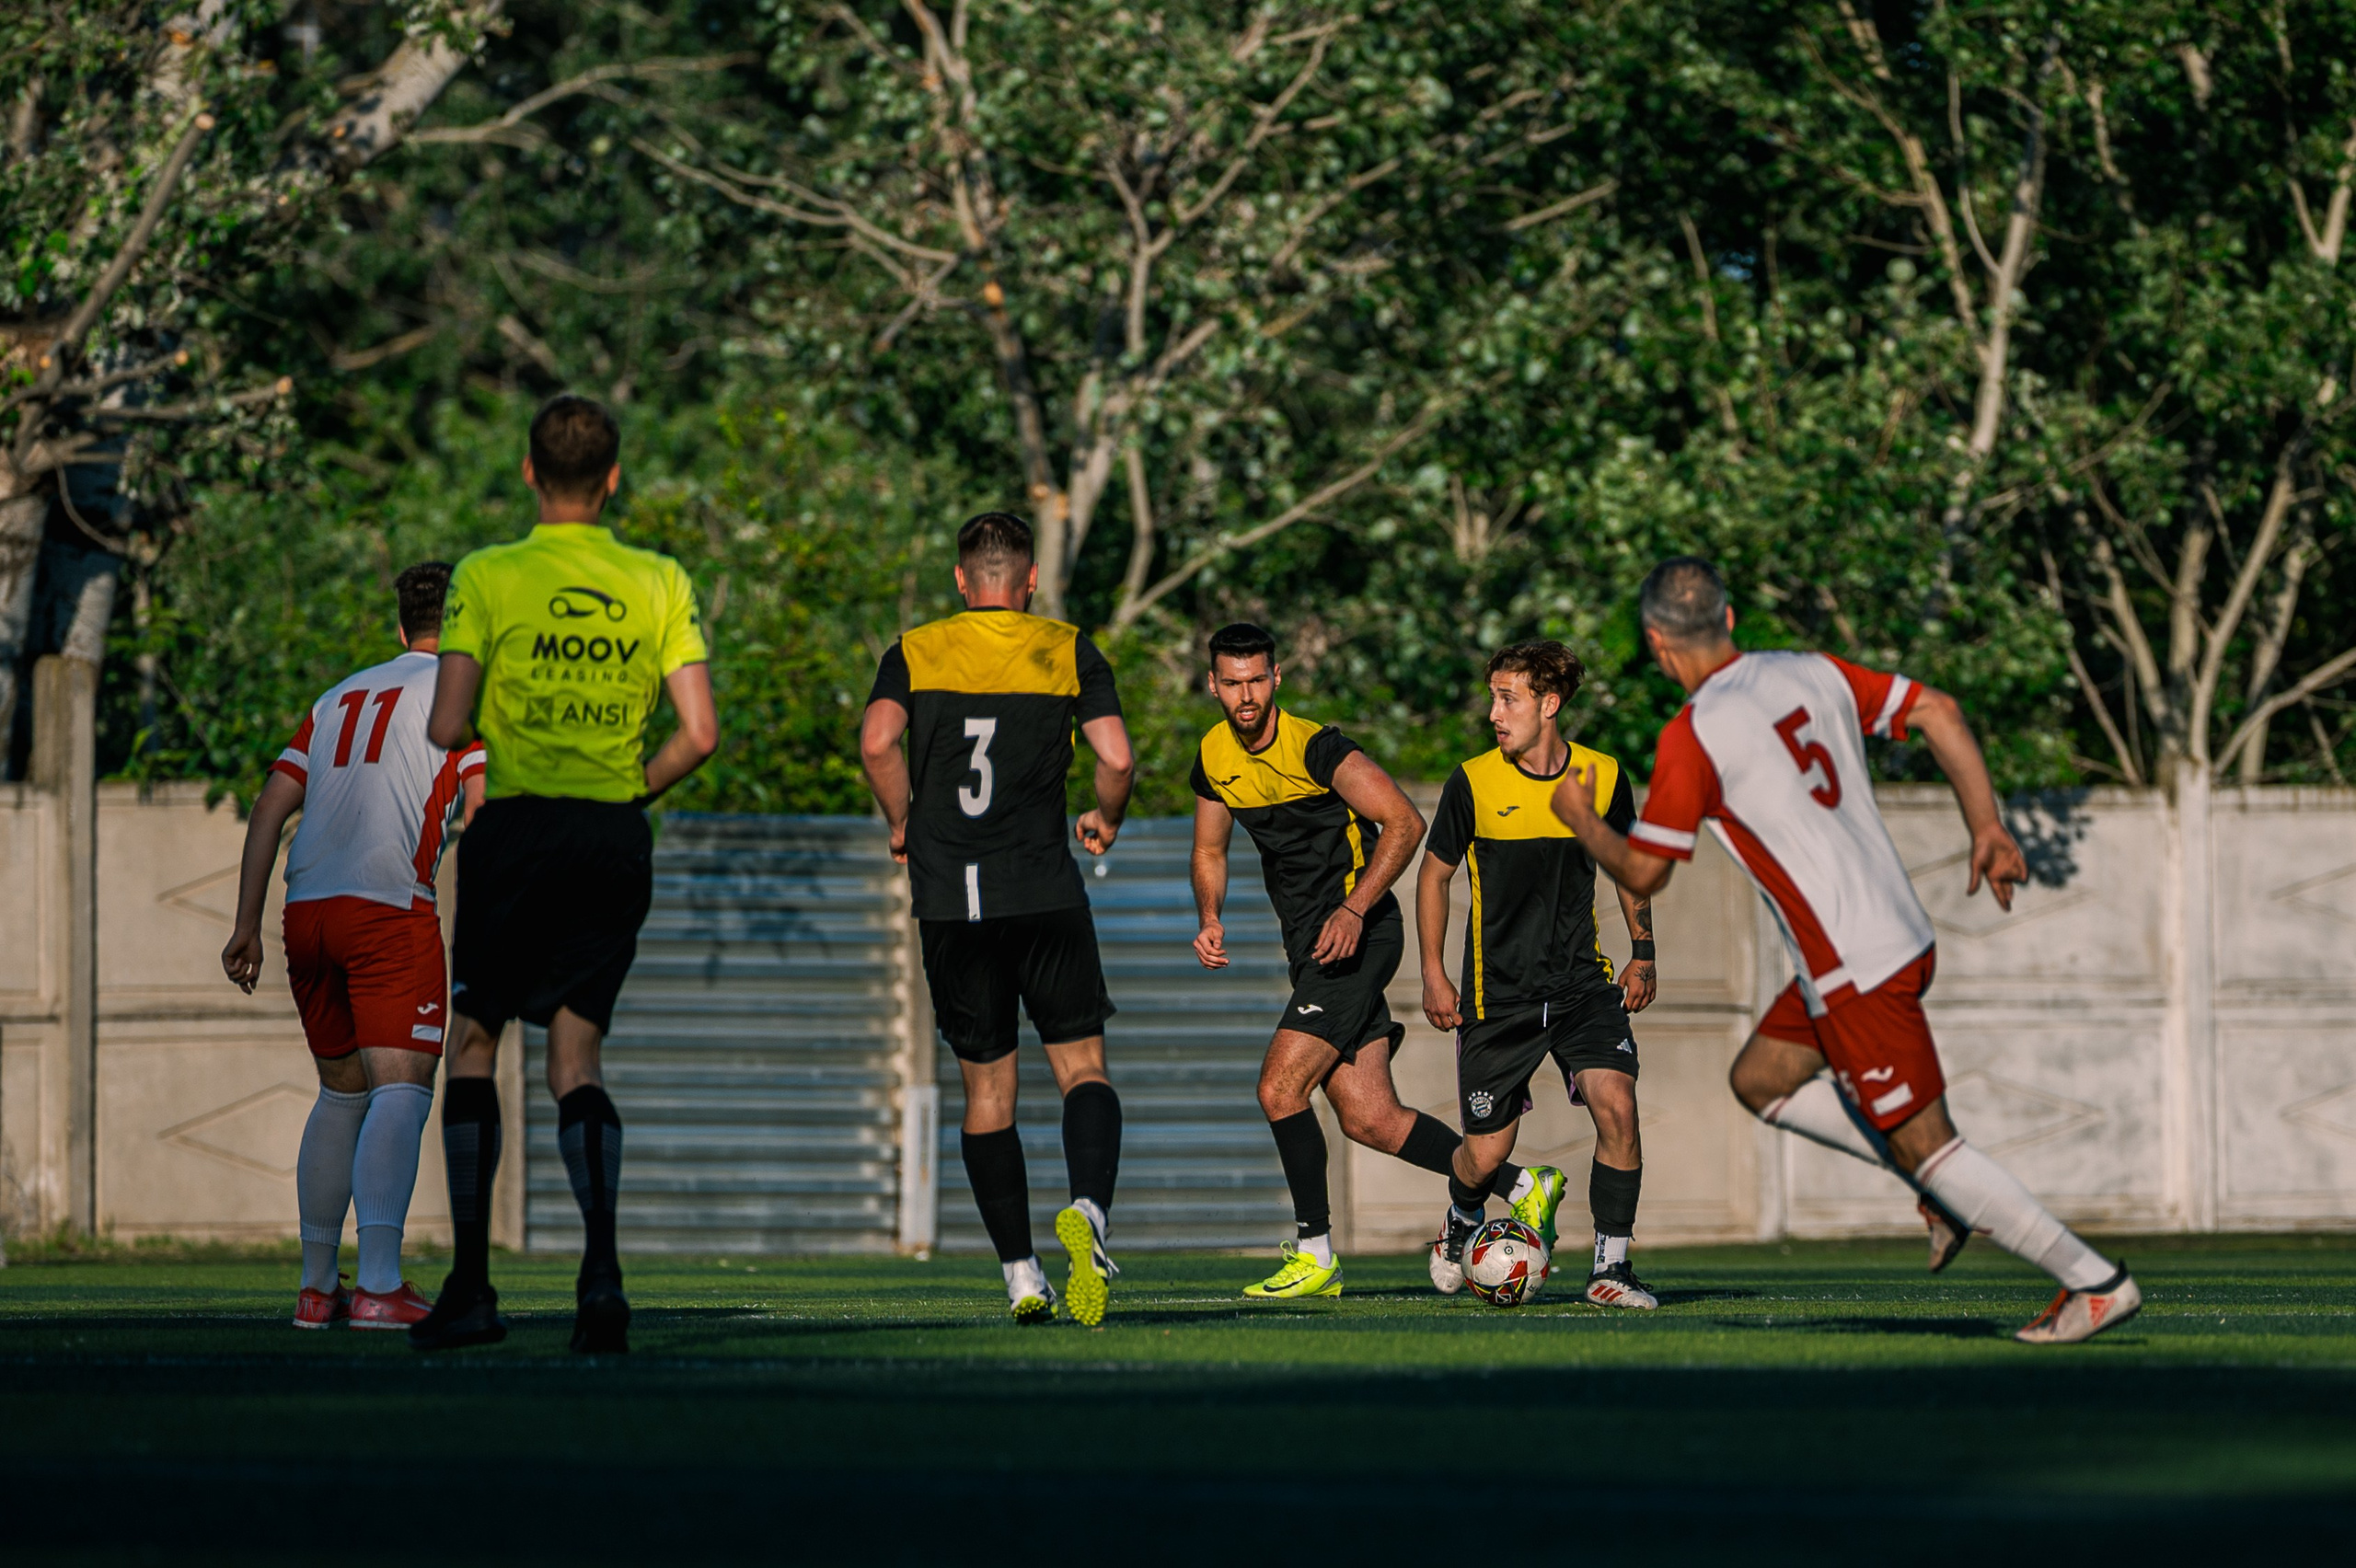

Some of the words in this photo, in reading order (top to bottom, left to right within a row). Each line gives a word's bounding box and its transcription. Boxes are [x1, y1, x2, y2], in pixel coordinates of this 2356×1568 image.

[531, 666, 628, 684] LEASING
[532, 632, 640, 664] MOOV
[333, 686, 404, 767] 11
[560, 701, 628, 726] ANSI
[958, 717, 997, 818] 3
[1773, 705, 1842, 810] 5
